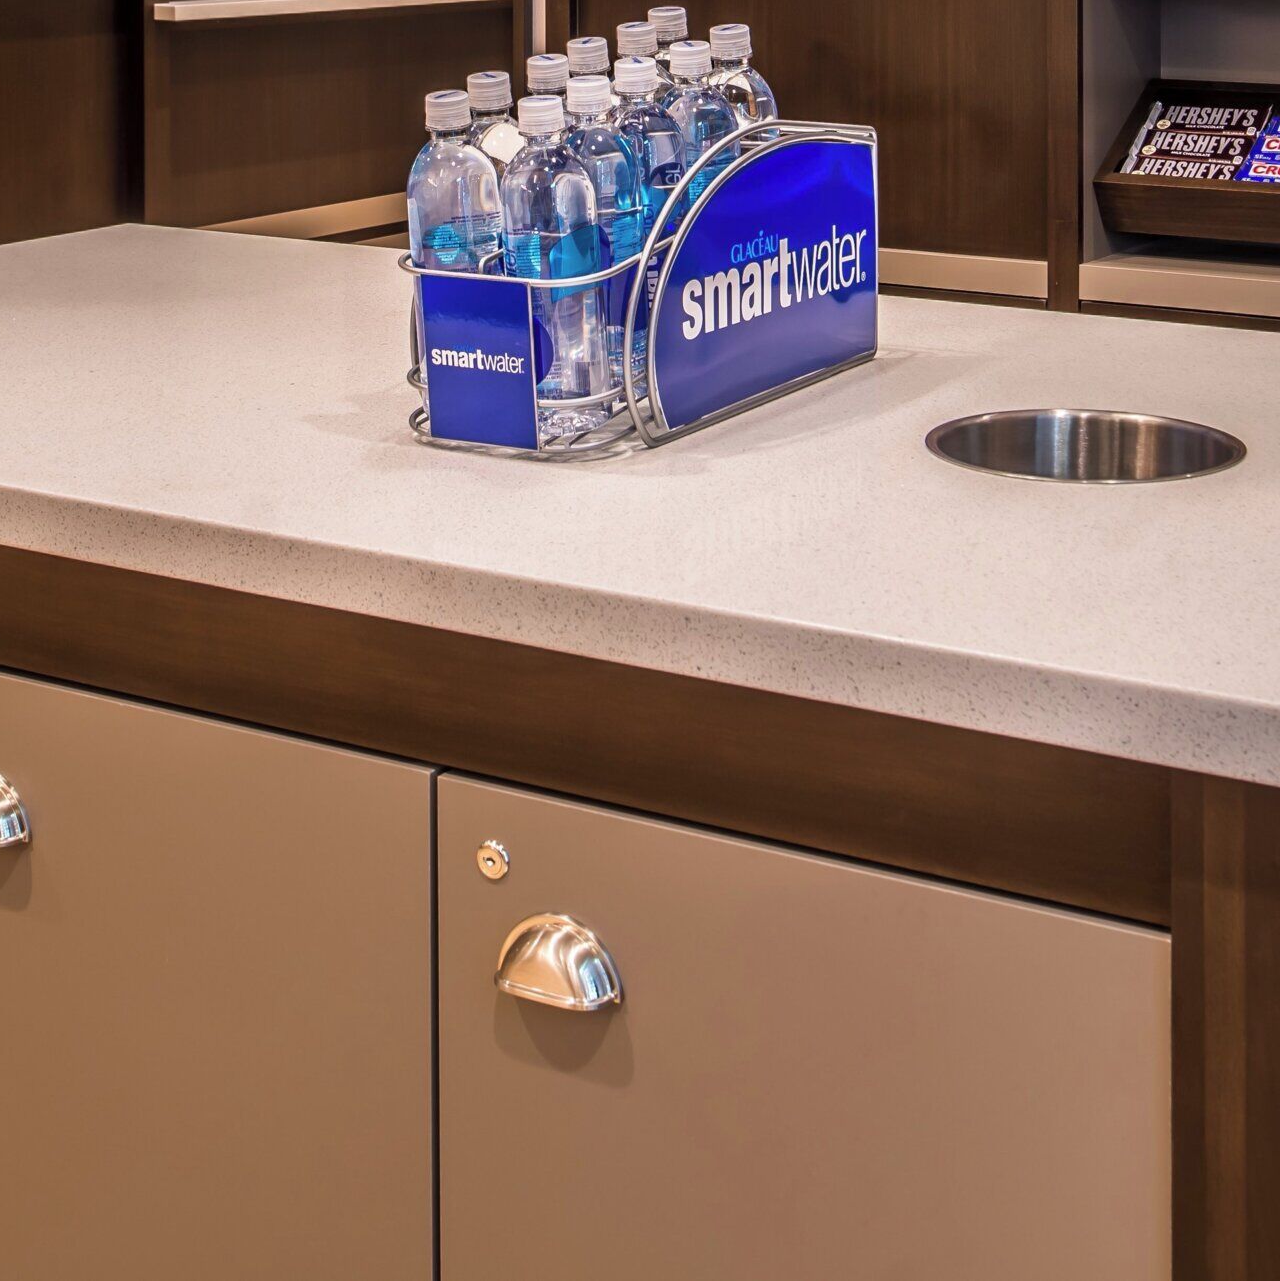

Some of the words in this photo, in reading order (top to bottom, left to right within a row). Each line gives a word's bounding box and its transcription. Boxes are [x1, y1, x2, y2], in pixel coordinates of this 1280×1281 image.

[1165, 105, 1259, 127] HERSHEY'S
[1150, 131, 1245, 156] HERSHEY'S
[1140, 158, 1235, 180] HERSHEY'S
[682, 224, 867, 340] smartwater
[431, 348, 524, 374] smartwater
